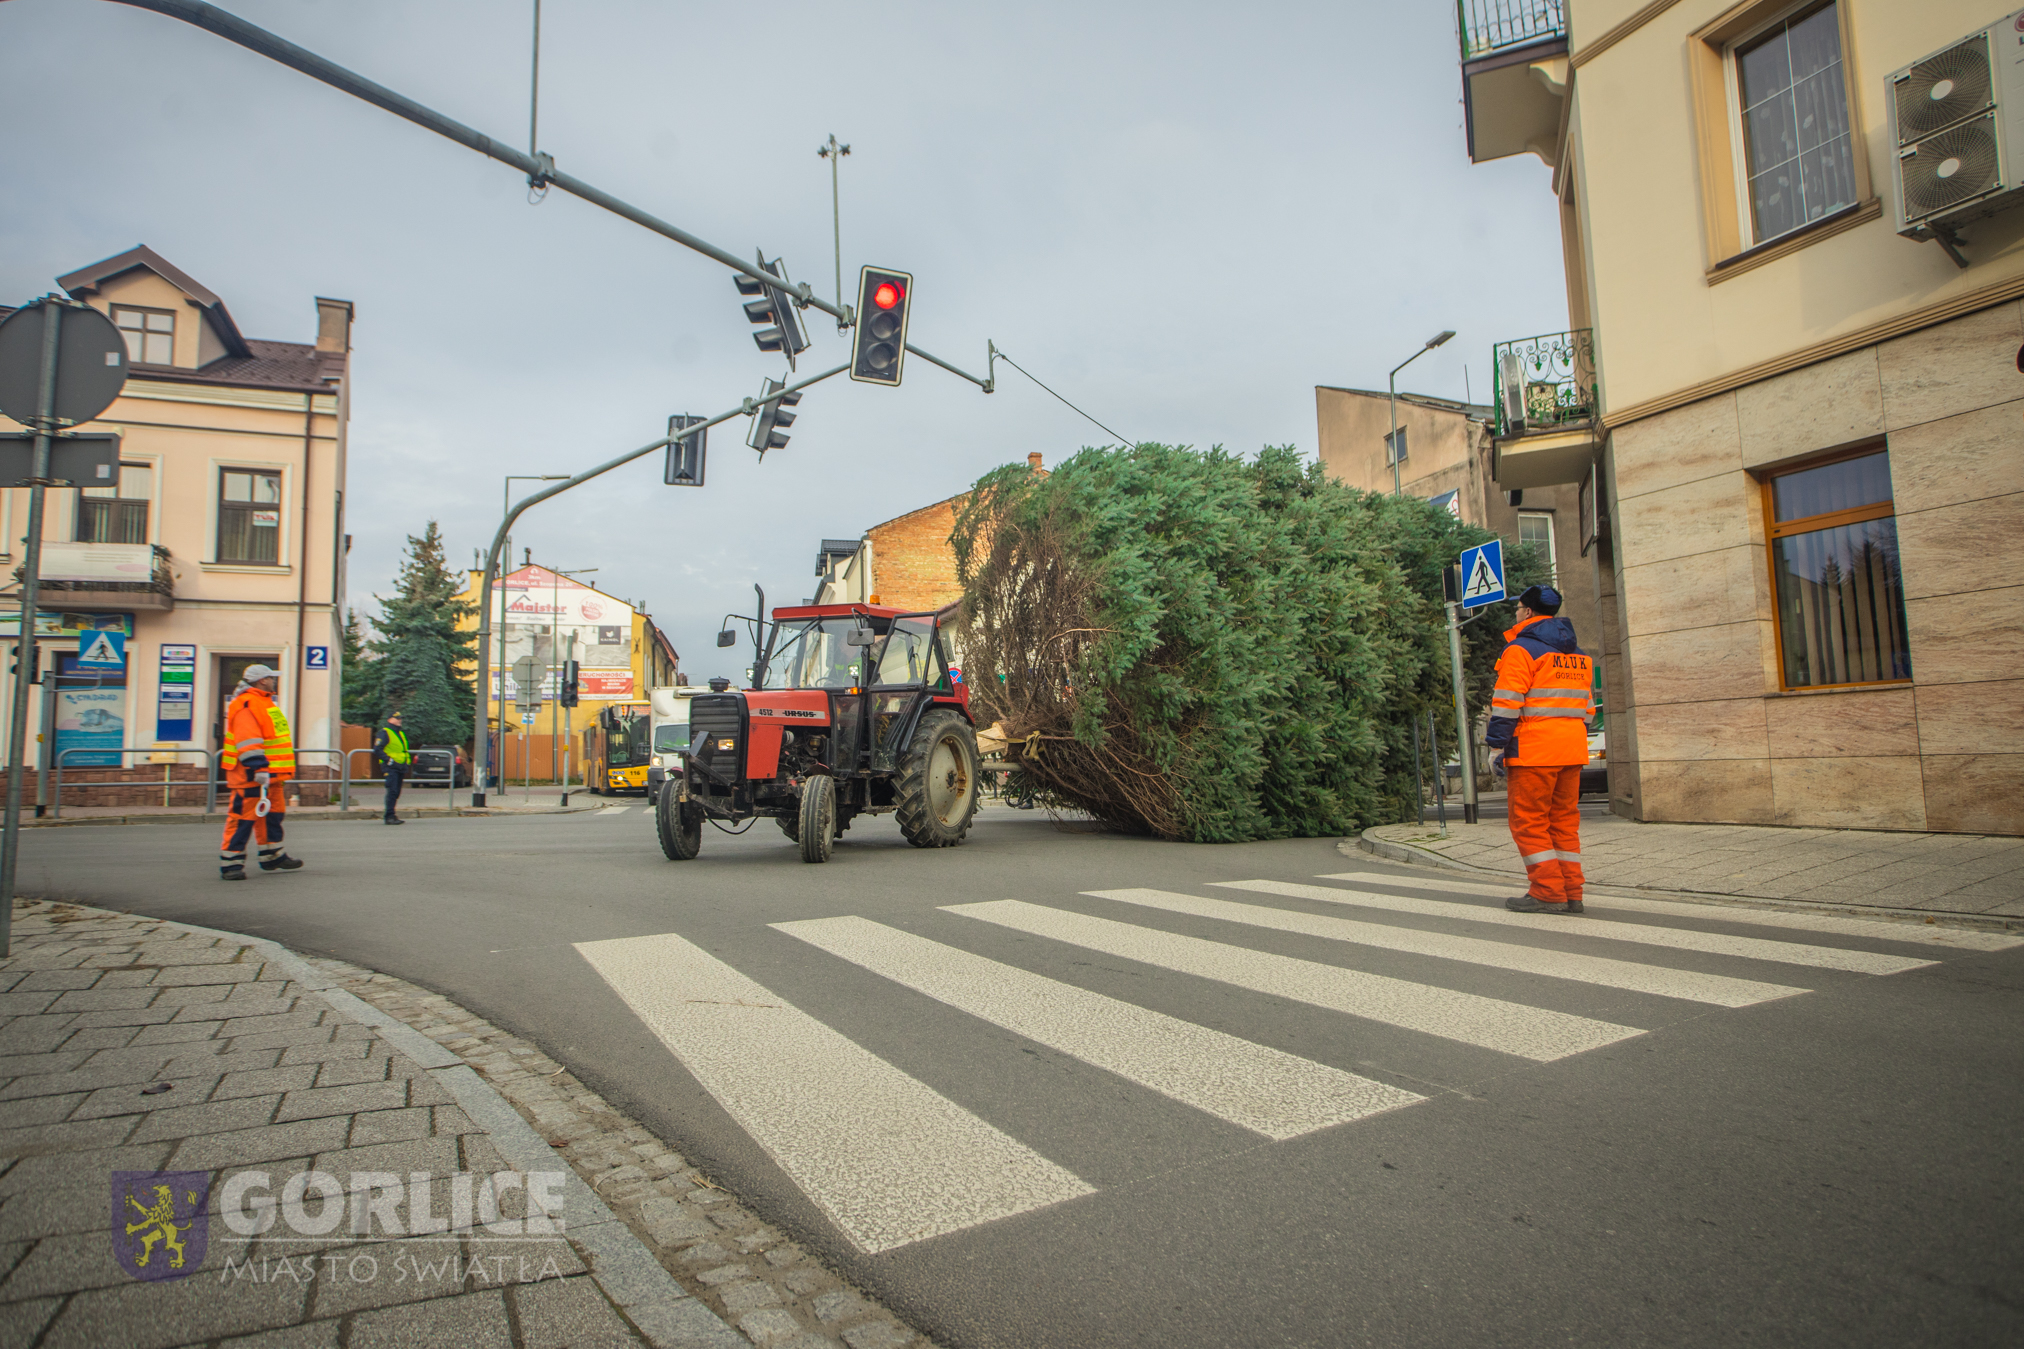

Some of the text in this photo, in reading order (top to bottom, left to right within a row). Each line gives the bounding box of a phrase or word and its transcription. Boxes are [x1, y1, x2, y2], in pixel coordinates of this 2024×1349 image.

[505, 579, 530, 587] ORLICE,
[511, 602, 567, 614] Majster
[310, 648, 324, 664] 2
